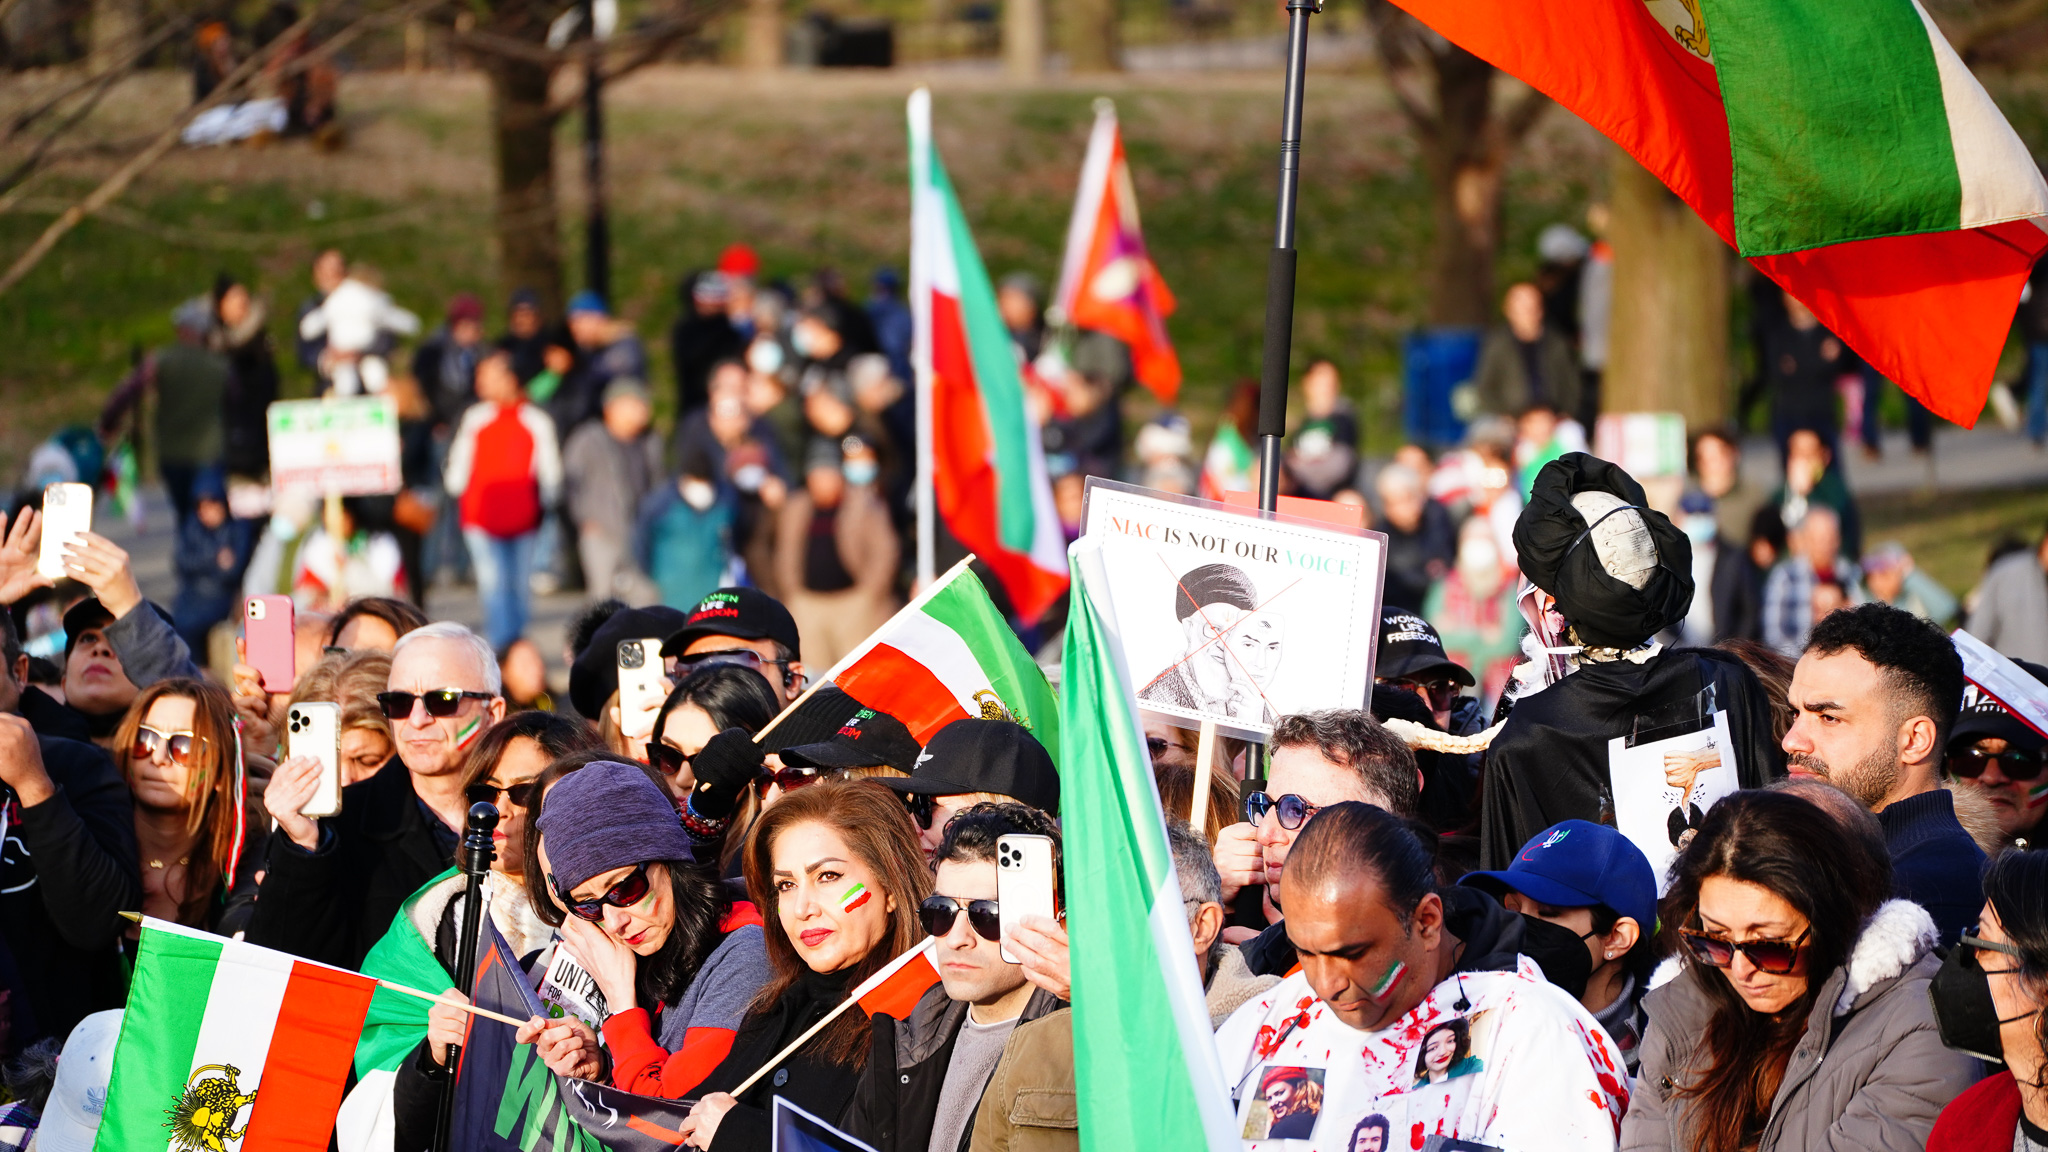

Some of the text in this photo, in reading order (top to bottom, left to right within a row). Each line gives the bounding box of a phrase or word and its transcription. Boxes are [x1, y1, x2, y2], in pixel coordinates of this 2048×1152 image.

[1110, 516, 1351, 577] NIAC IS NOT OUR VOICE
[700, 600, 725, 612] LIFE
[1384, 614, 1429, 628] WOMEN
[1399, 622, 1426, 633] LIFE
[1386, 631, 1441, 647] FREEDOM
[547, 985, 562, 1001] FOR
